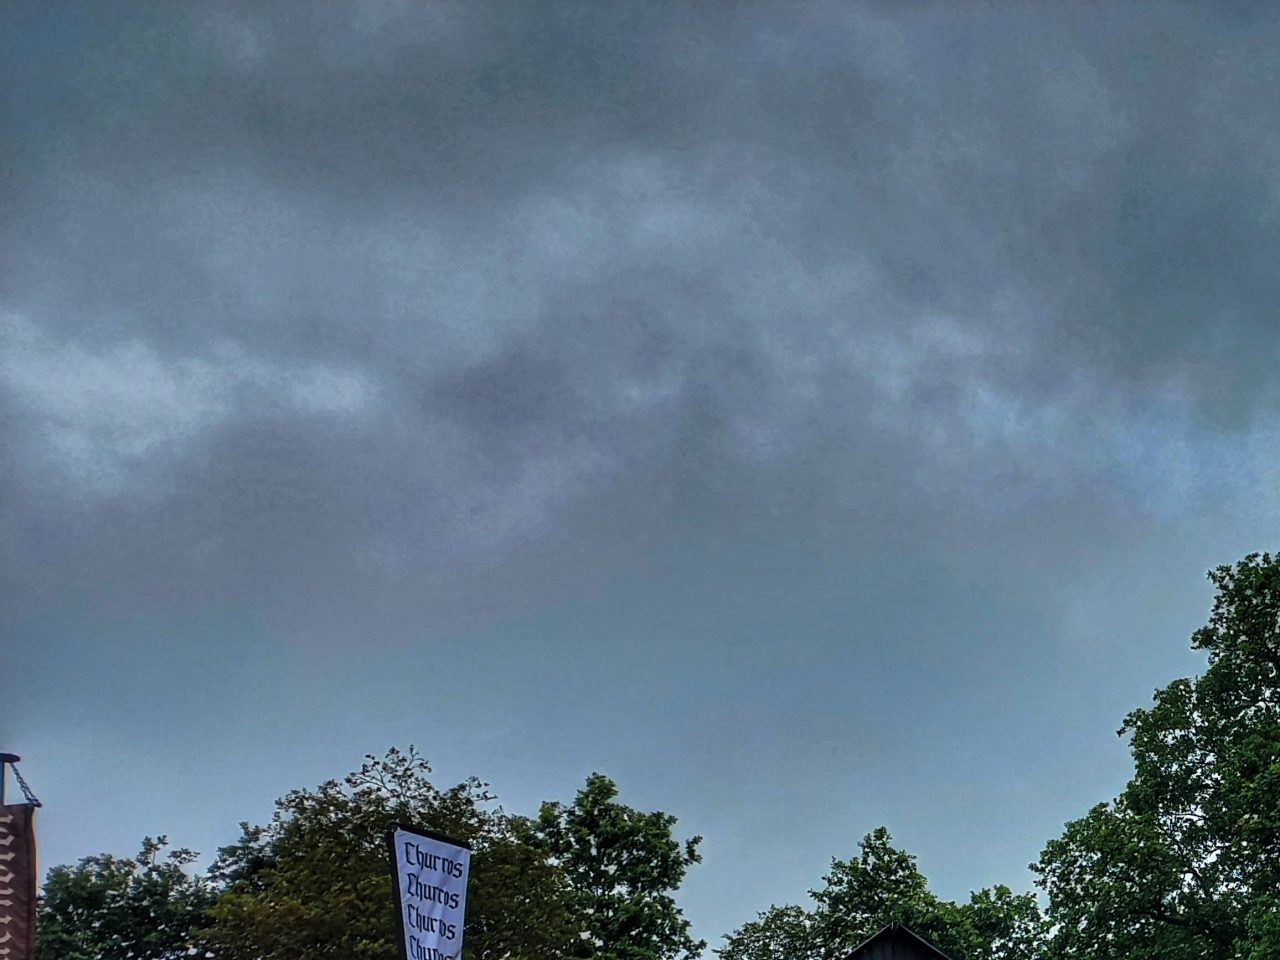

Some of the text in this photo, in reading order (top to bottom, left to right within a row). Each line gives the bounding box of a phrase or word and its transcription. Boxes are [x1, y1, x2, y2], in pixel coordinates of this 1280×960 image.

[404, 842, 463, 879] Churros
[406, 873, 459, 910] Churros
[407, 903, 456, 941] Churos
